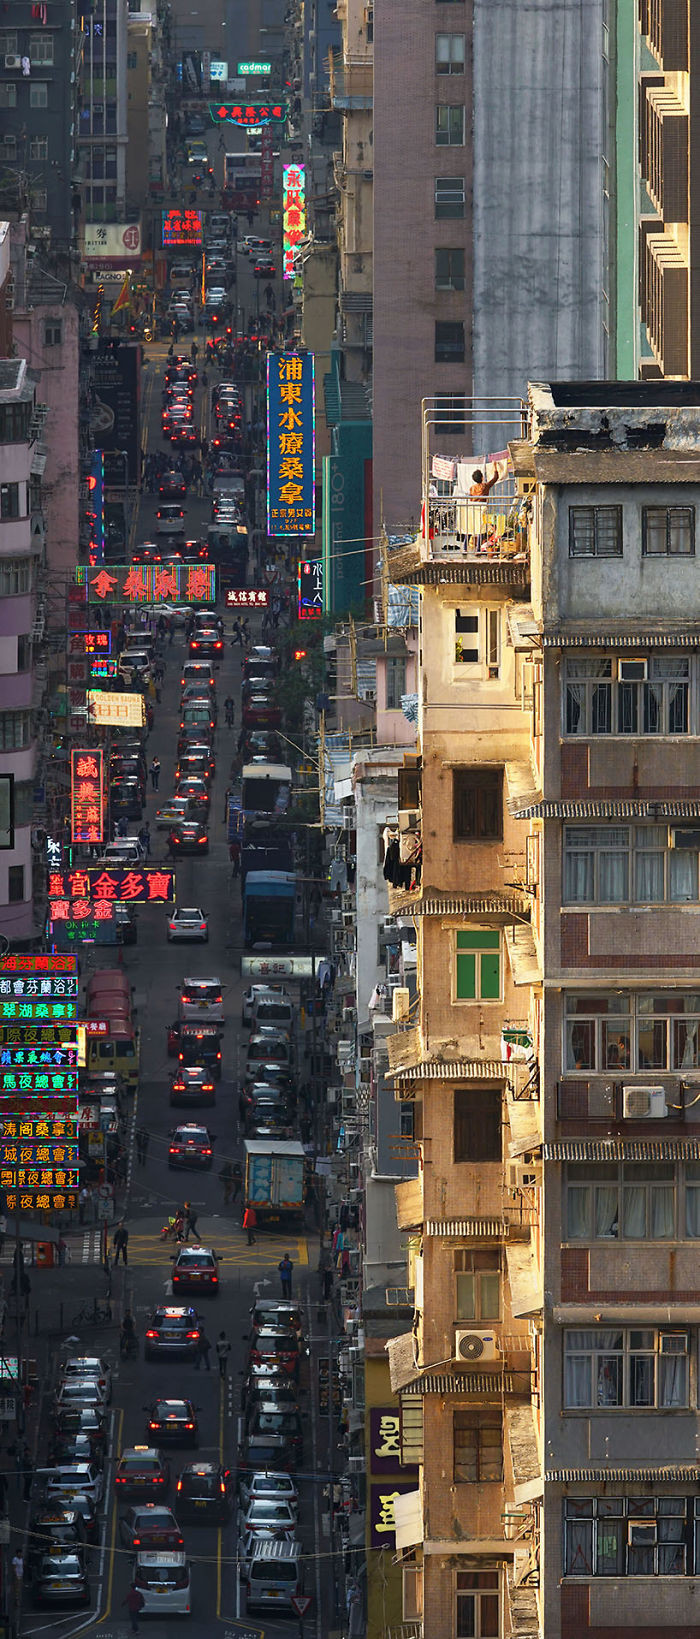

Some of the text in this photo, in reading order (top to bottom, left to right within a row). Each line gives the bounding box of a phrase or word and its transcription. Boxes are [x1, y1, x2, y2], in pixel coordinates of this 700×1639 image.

[278, 357, 304, 505] 浦東水療桑拿
[91, 871, 172, 900] 金多寶
[0, 980, 65, 994] 都會芬蘭浴
[2, 1003, 65, 1018] 翠湖桑拿
[0, 1028, 72, 1042] 際夜總會
[3, 1074, 65, 1089] 馬夜總會
